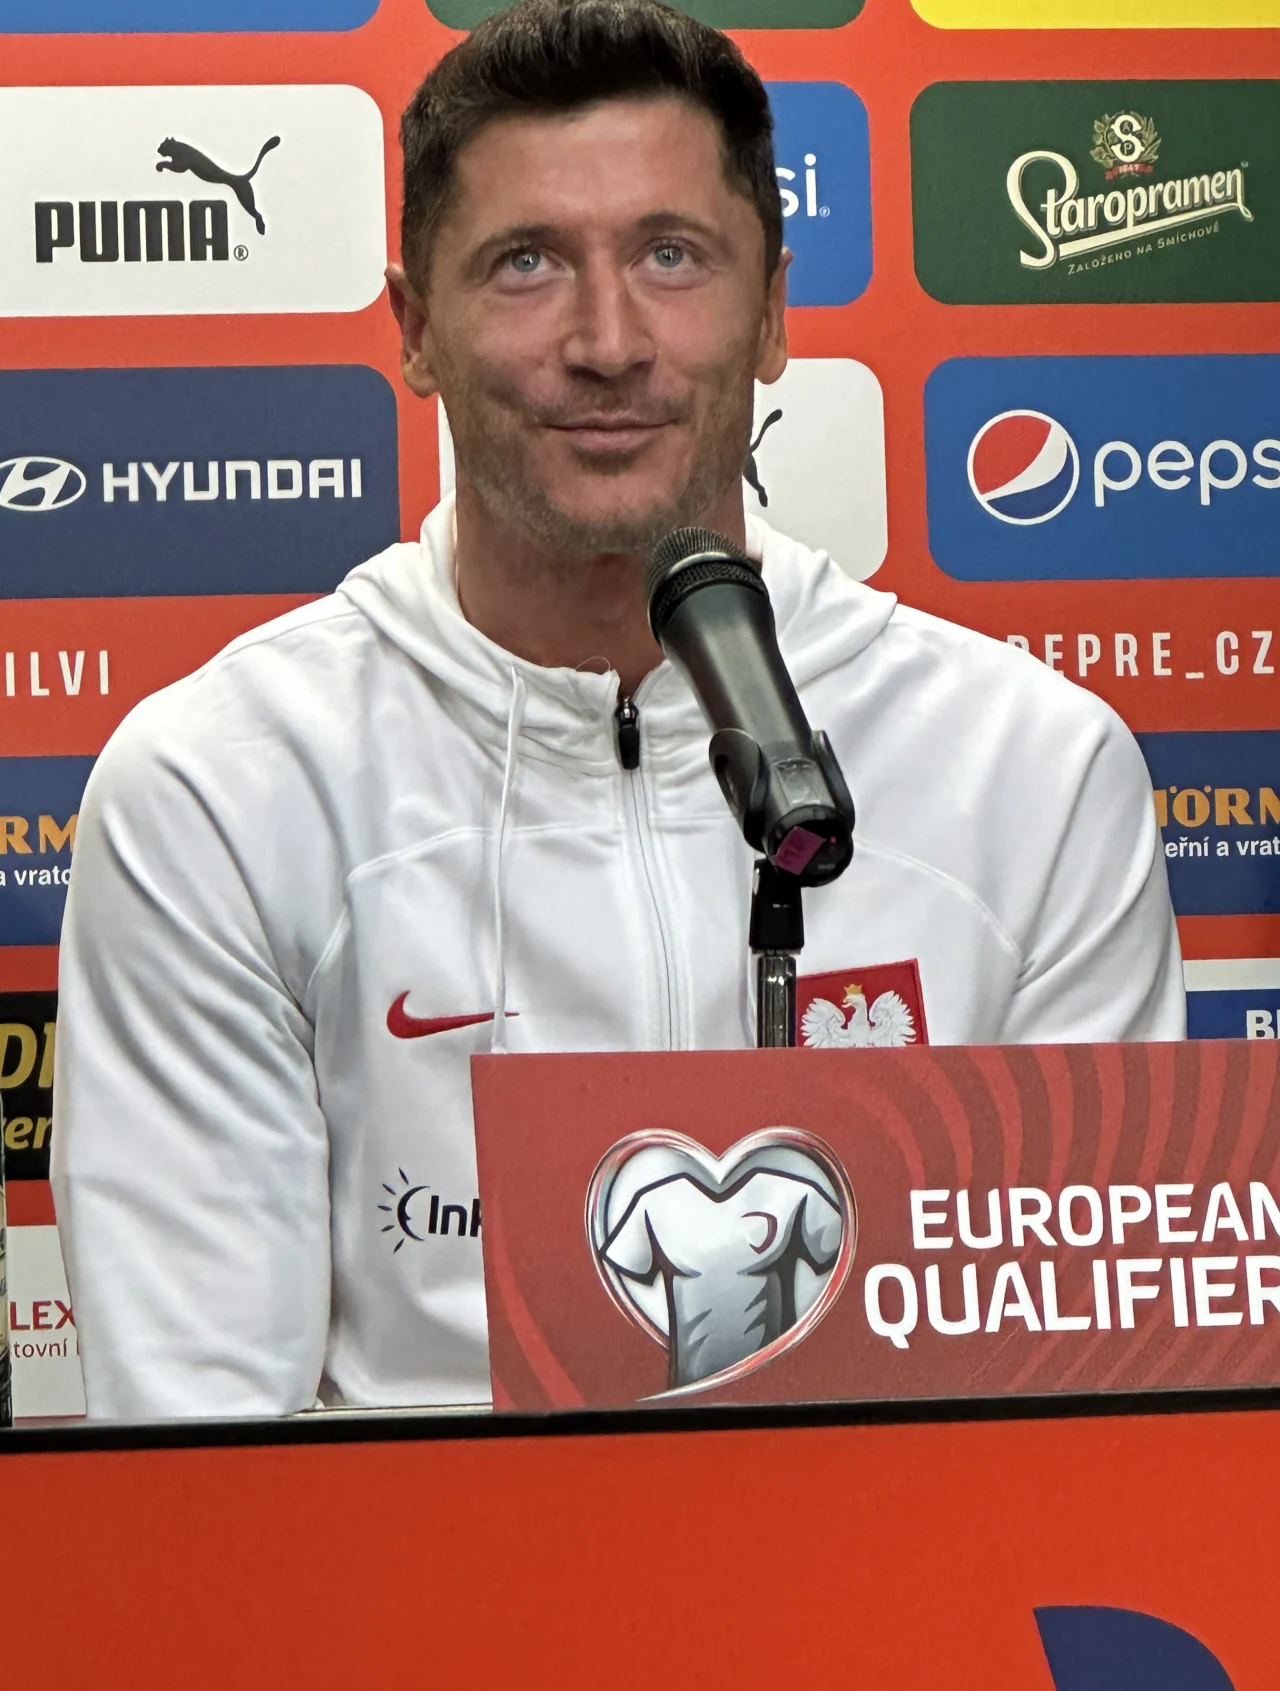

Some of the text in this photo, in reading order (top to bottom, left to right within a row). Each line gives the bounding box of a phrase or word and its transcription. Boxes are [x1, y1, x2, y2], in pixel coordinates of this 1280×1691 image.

[35, 200, 229, 263] PUMA
[1006, 150, 1254, 270] Staropramen
[1136, 244, 1153, 256] NA
[103, 458, 362, 503] HYUNDAI
[1216, 840, 1230, 857] a
[909, 1181, 1280, 1250] EUROPEAN
[864, 1255, 1280, 1349] QUALIFIER
